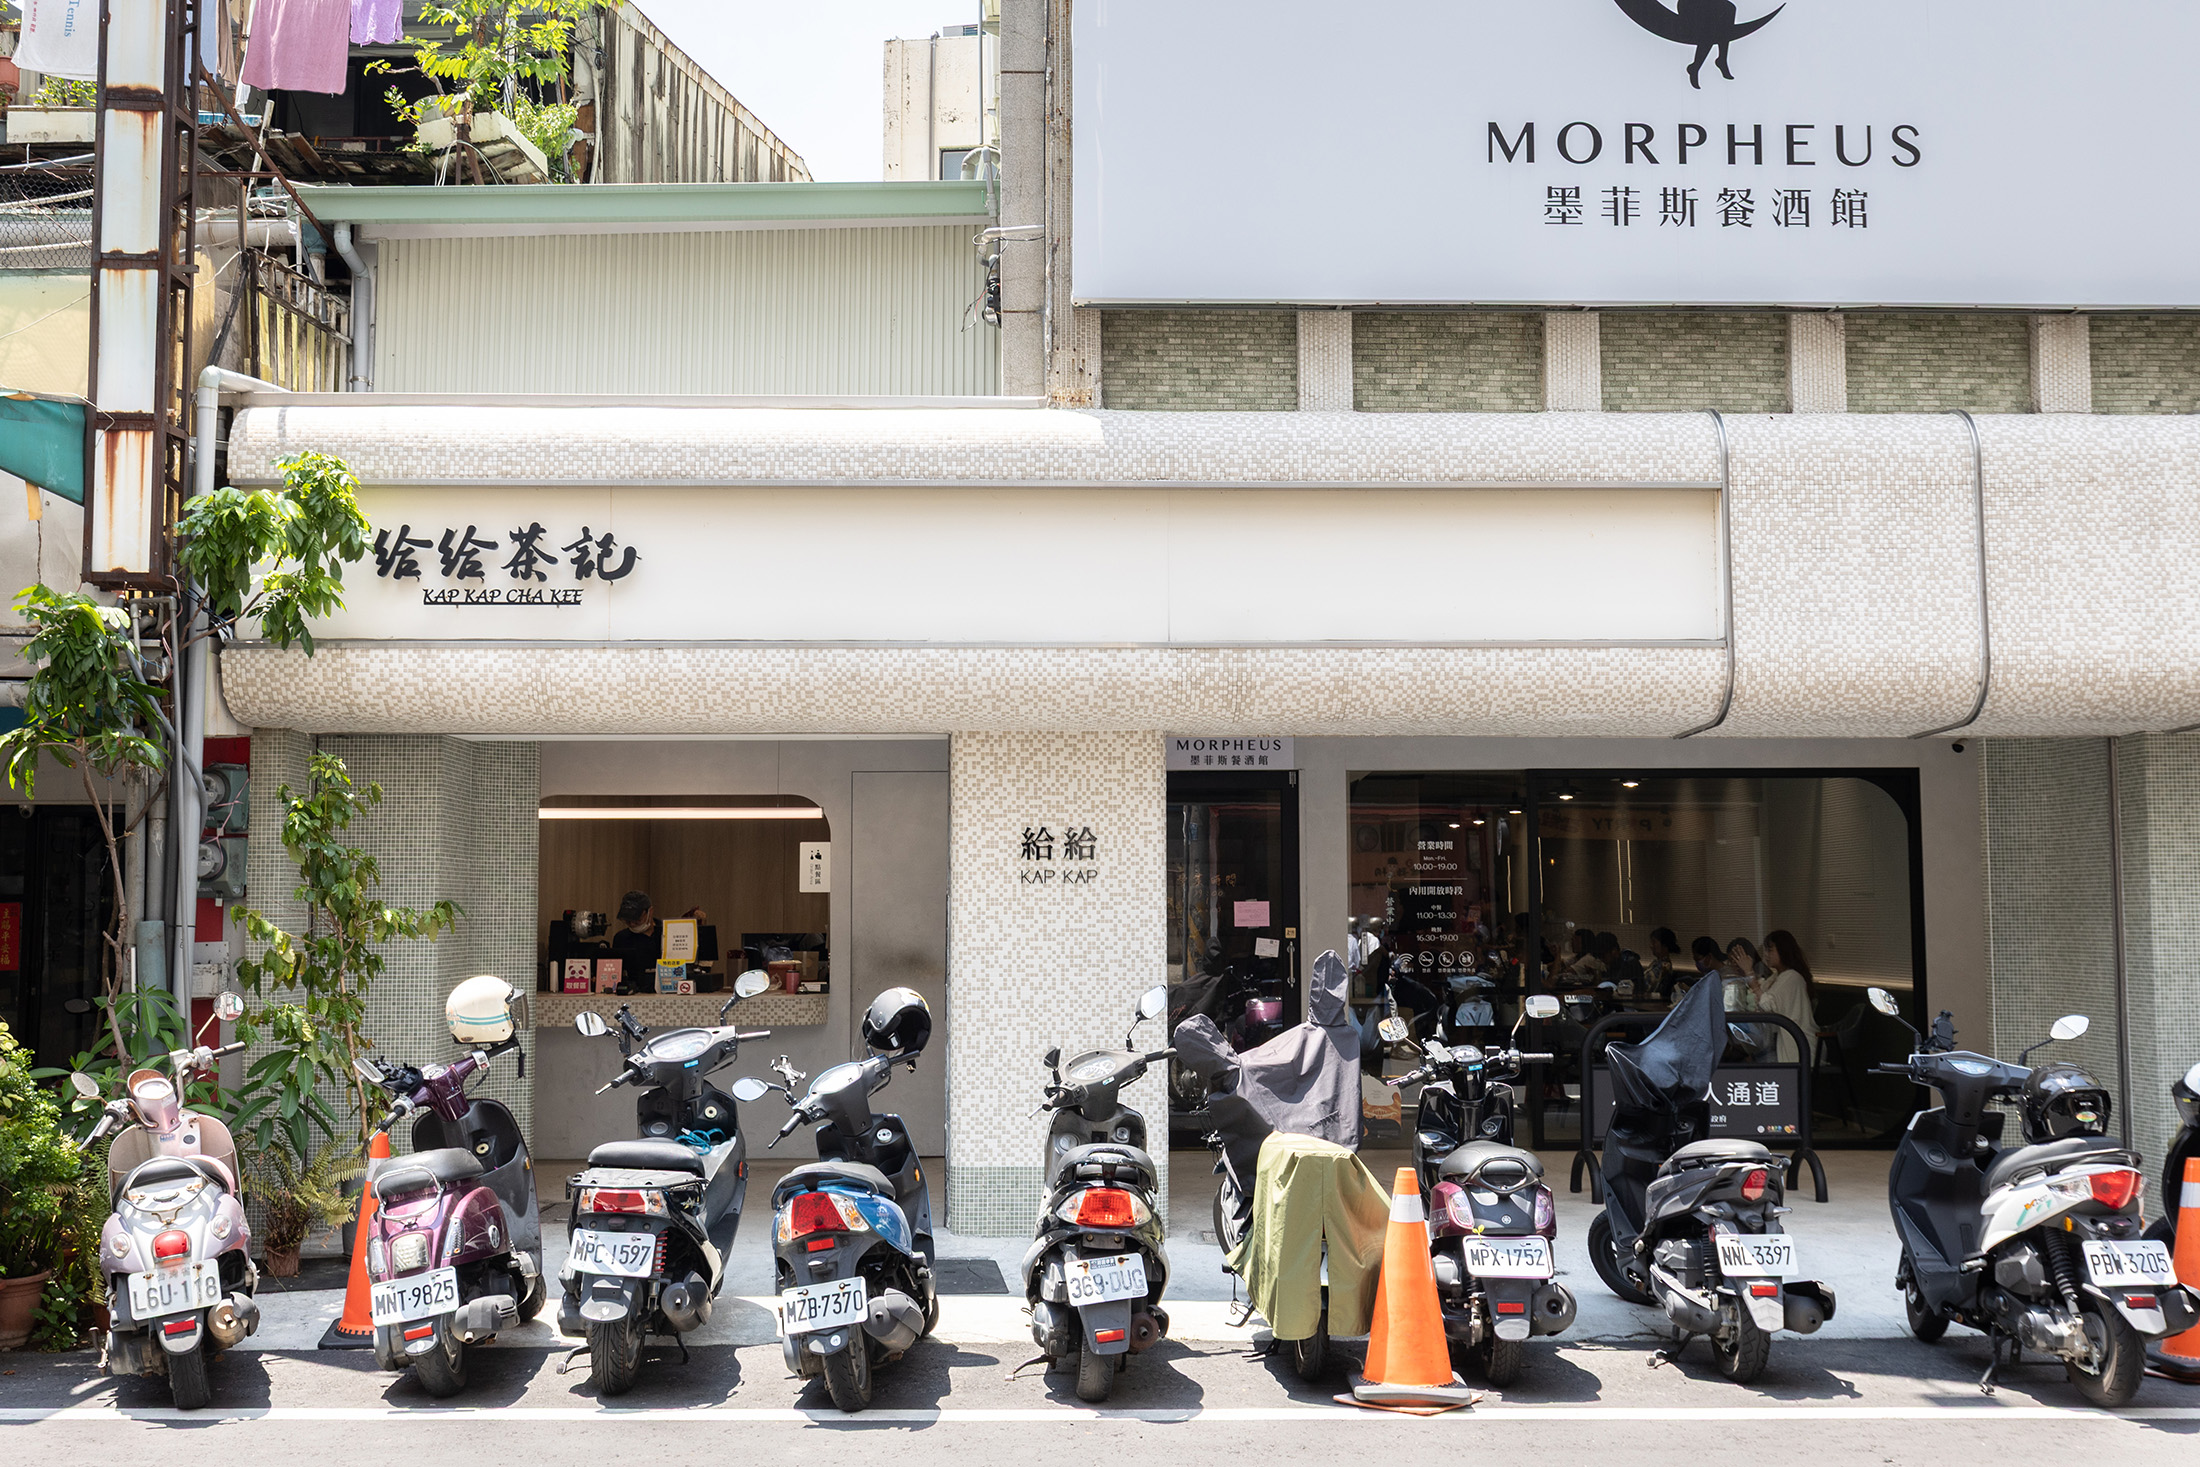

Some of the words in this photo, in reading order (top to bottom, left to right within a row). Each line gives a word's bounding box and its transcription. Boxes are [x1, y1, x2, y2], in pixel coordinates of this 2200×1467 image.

[64, 0, 80, 37] Tennis
[1487, 121, 1921, 168] MORPHEUS
[1544, 185, 1869, 229] 墨菲斯餐酒館
[422, 588, 460, 603] KAP
[464, 588, 502, 603] KAP
[505, 588, 544, 603] CHA
[549, 588, 584, 603] KEE
[1176, 739, 1282, 751] MORPHEUS
[1190, 755, 1268, 766] 墨菲斯餐酒館
[1021, 826, 1097, 861] 給給
[1417, 841, 1453, 850] 營業時間
[1020, 869, 1056, 884] KAP
[1063, 869, 1098, 884] KAP
[1385, 897, 1395, 925] 營業中
